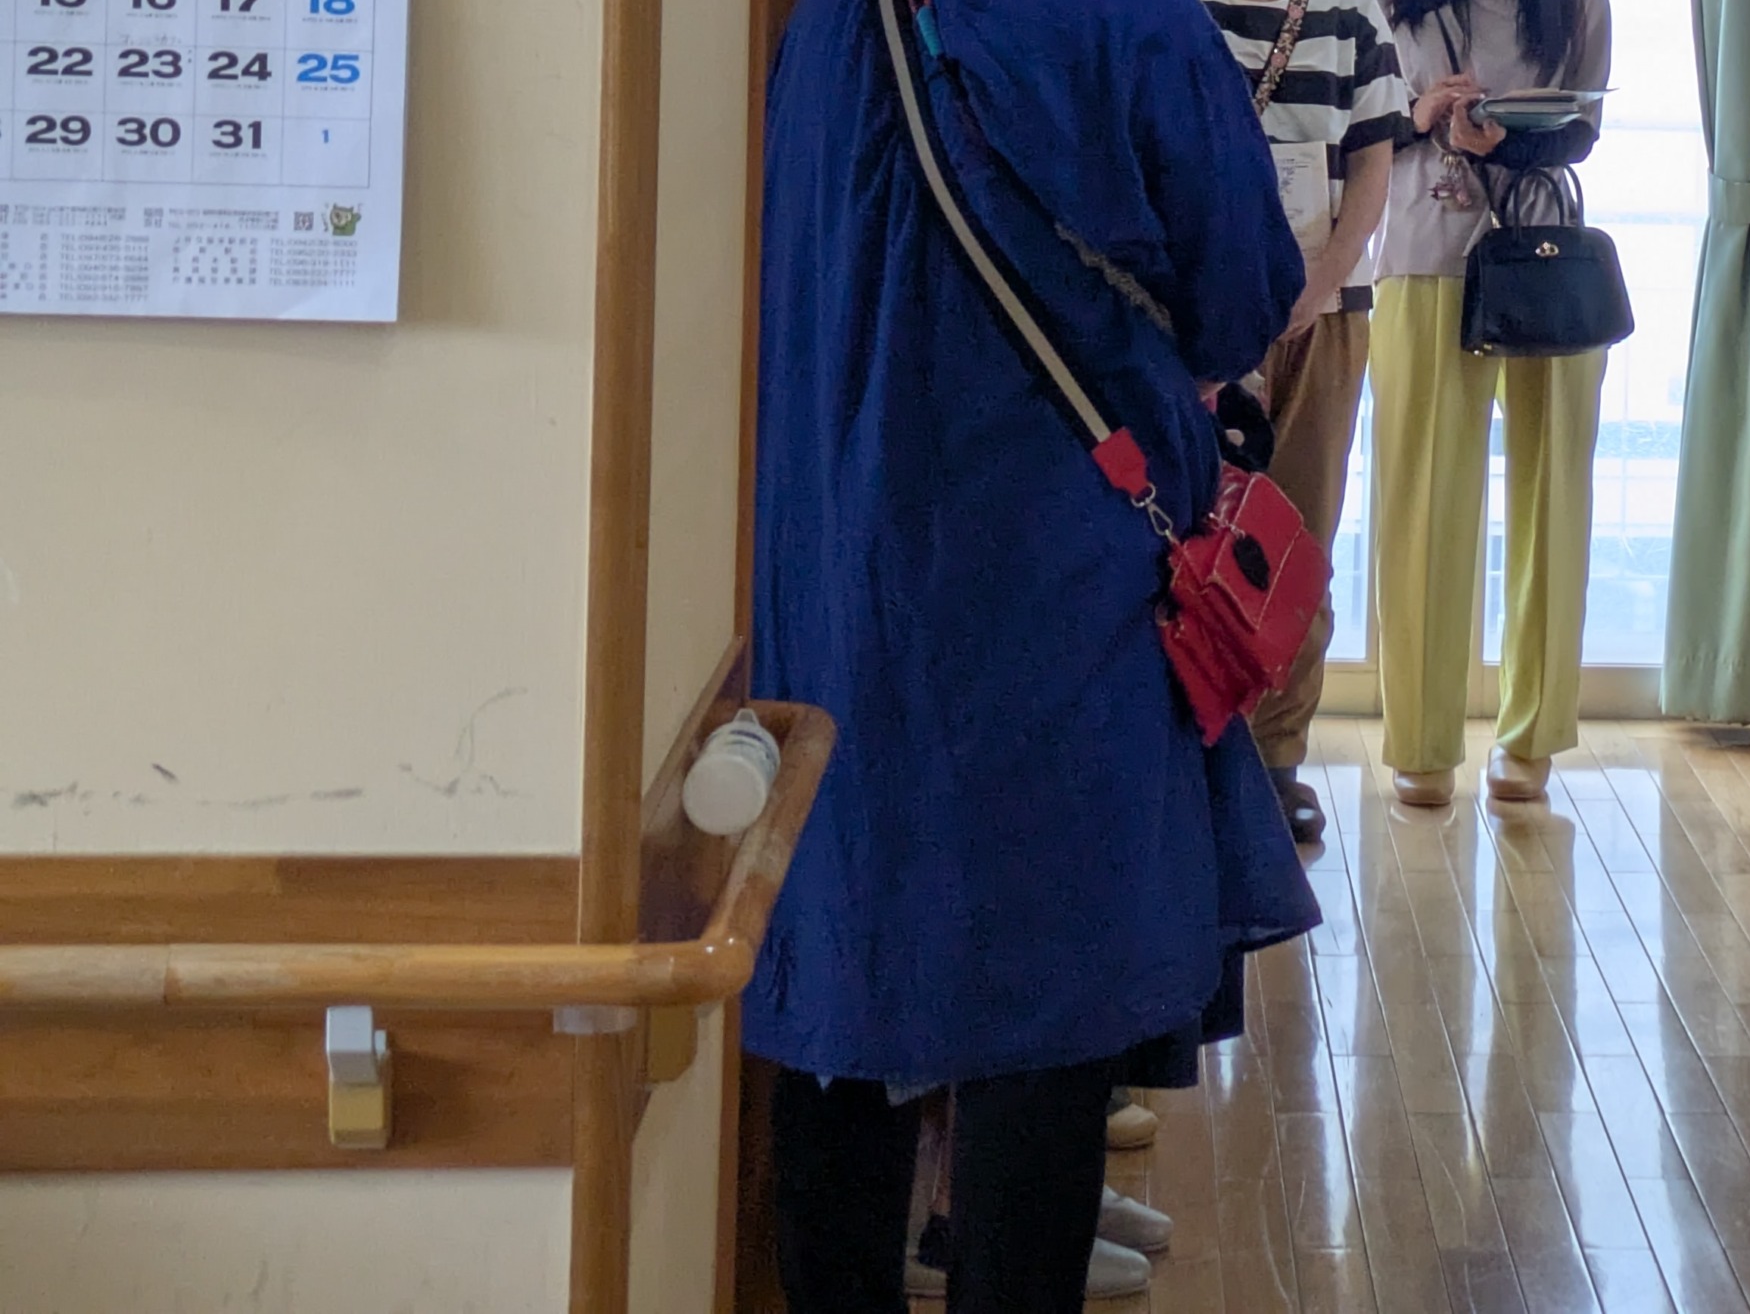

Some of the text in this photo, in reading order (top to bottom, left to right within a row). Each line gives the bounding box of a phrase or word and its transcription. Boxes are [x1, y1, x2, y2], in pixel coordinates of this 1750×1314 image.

[26, 46, 360, 84] 22 23 24 25
[25, 115, 330, 150] 29 30 31 1
